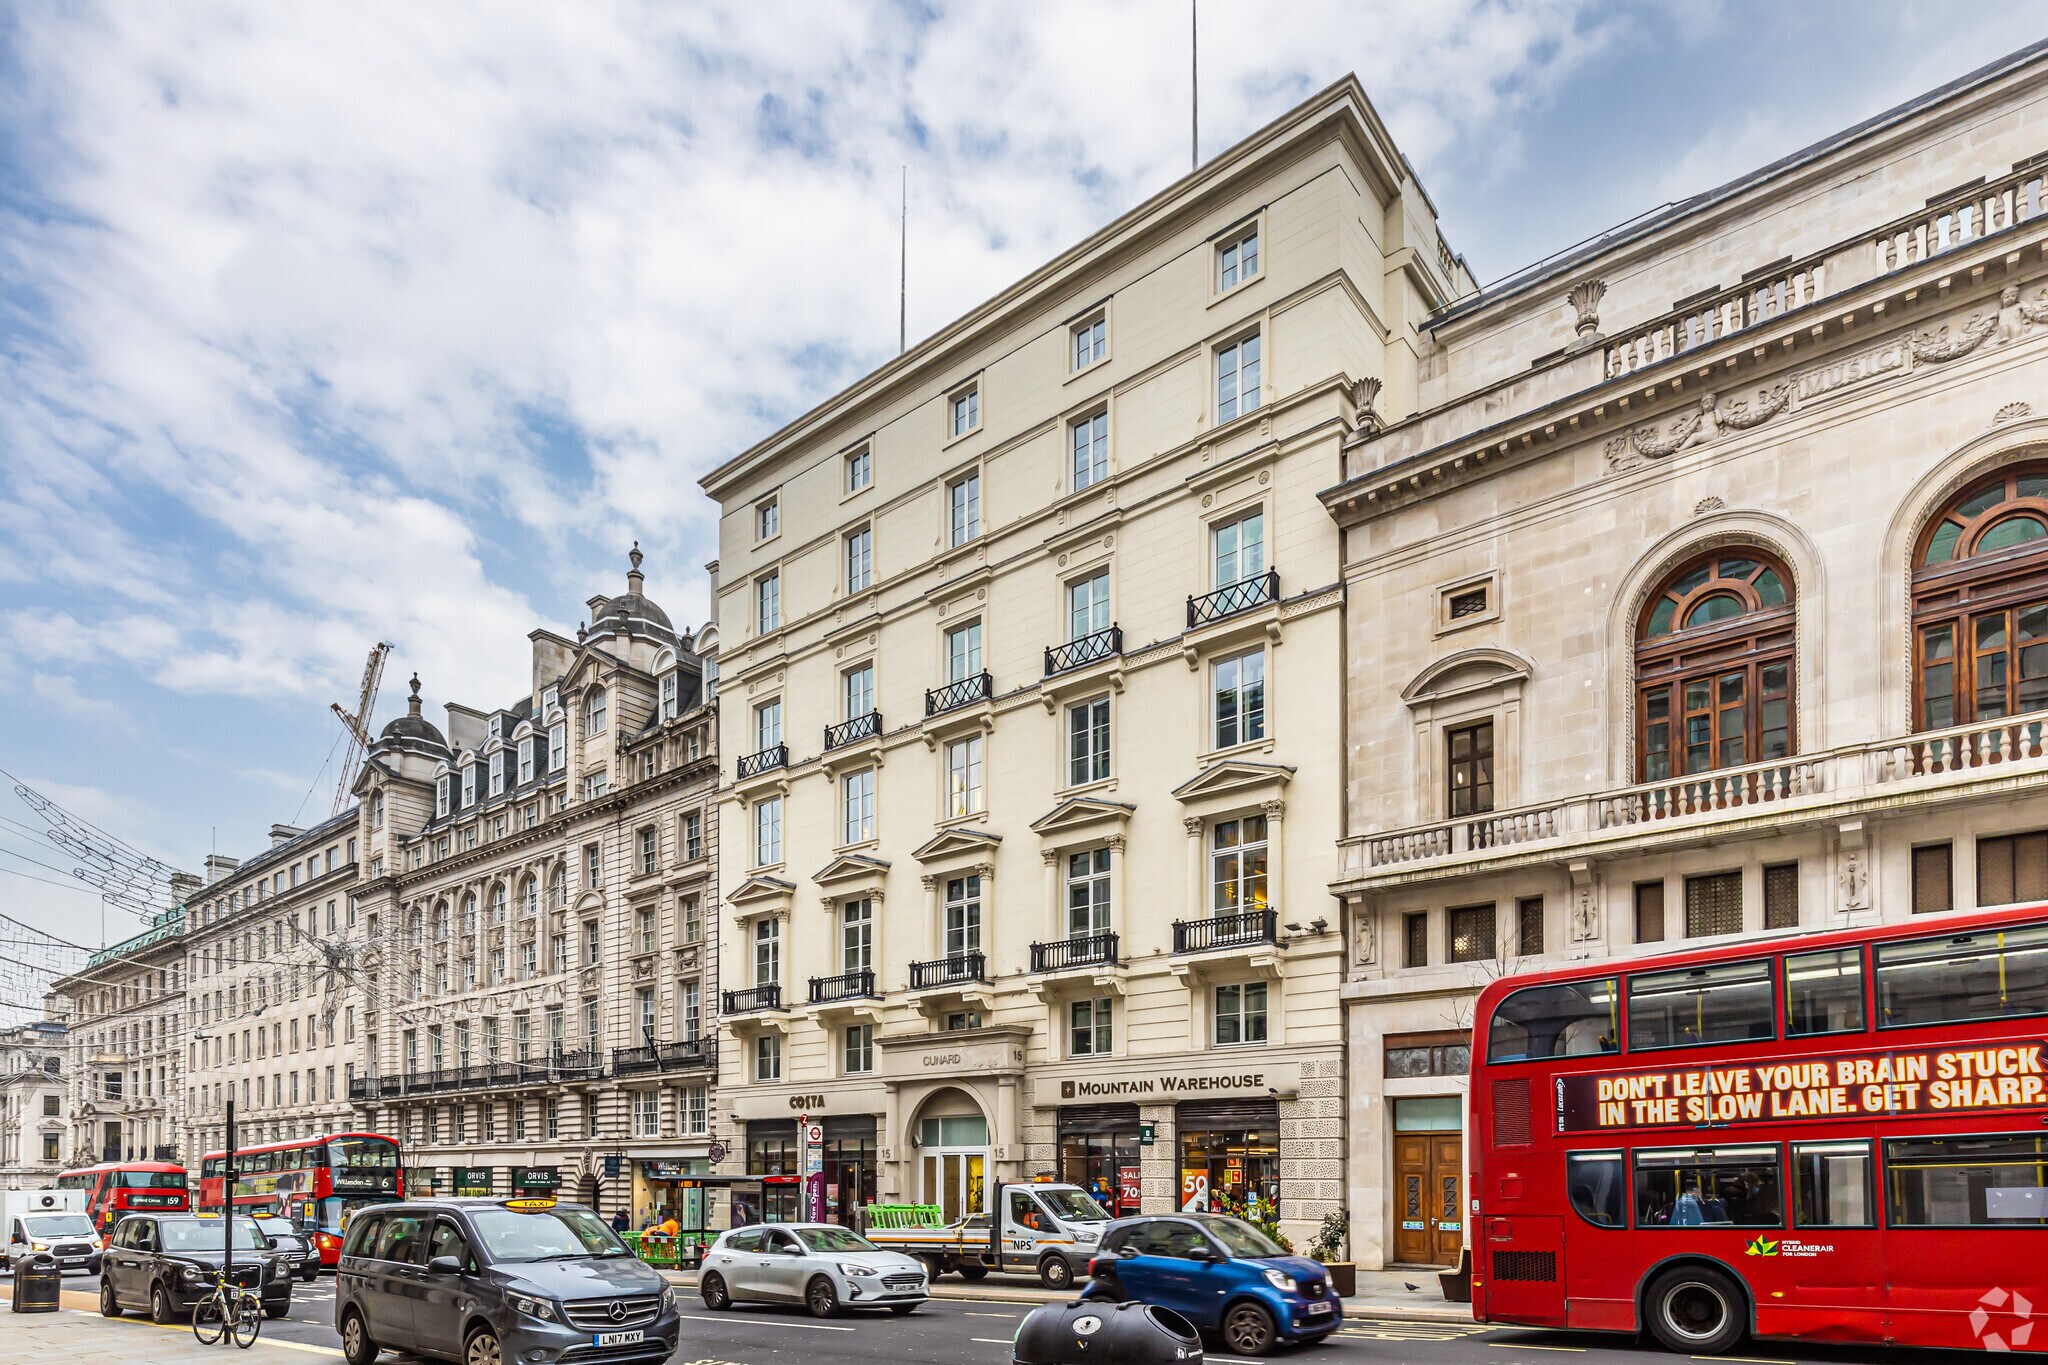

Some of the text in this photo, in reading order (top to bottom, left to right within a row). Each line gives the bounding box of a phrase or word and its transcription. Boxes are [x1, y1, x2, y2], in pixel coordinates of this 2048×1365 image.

[923, 1053, 961, 1067] CUNARD
[1013, 1050, 1023, 1062] 15
[1598, 1046, 2043, 1101] DON'T LEAVE YOUR BRAIN STUCK
[1078, 1074, 1264, 1096] MOUNTAIN WAREHOUSE
[789, 1095, 825, 1110] COSTA
[1598, 1075, 2047, 1126] IN THE SLOW LANE. GET SHARP.
[881, 1149, 891, 1159] 15
[994, 1147, 1005, 1159] 15
[467, 1172, 486, 1180] ORVIS
[527, 1172, 549, 1180] ORVIS
[381, 1178, 389, 1188] 6
[1183, 1175, 1208, 1193] 50
[810, 1181, 820, 1204] Open.
[167, 1197, 179, 1205] 159
[1013, 1240, 1032, 1250] NPS
[602, 1331, 641, 1344] LN17 MXY
